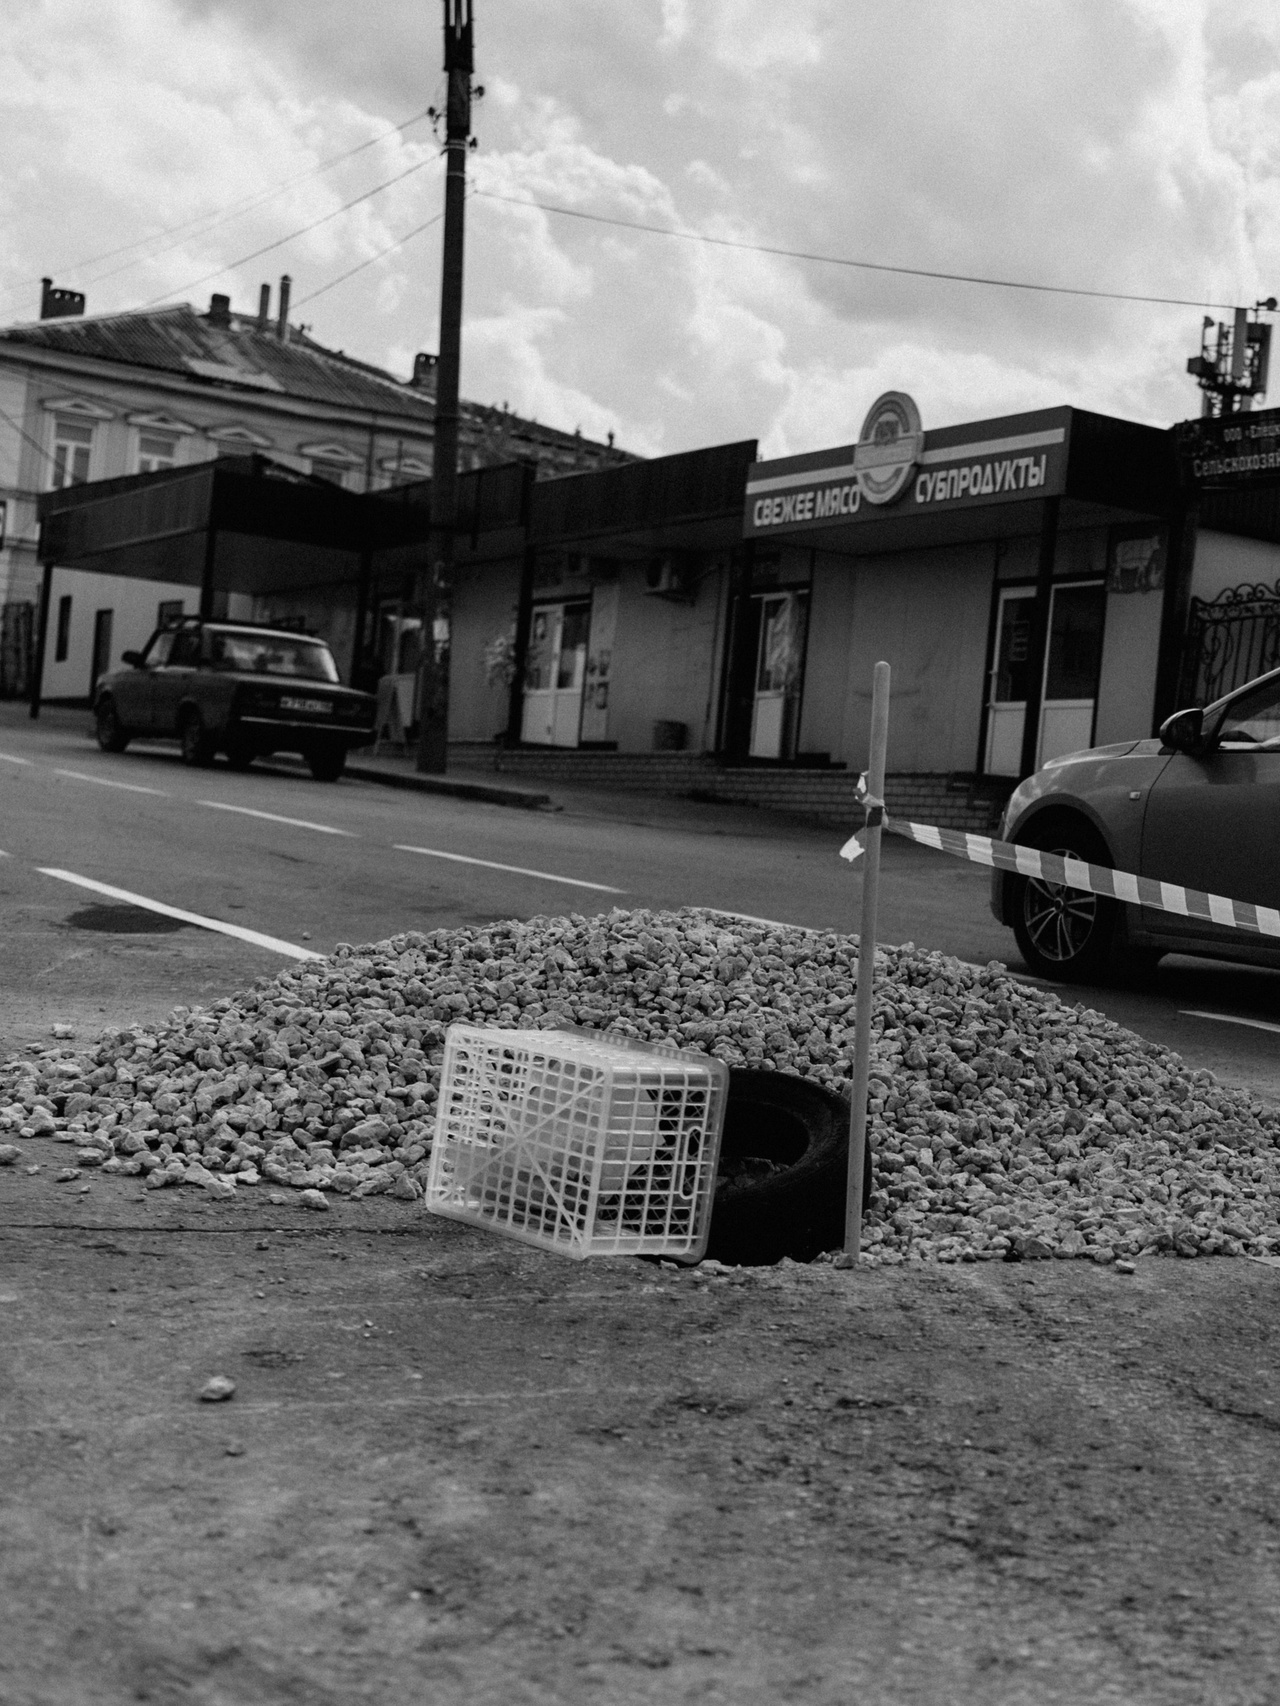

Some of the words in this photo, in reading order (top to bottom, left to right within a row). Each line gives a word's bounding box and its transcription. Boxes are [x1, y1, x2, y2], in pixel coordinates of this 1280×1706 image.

[915, 454, 1048, 504] СУБПРОДУКТЫ
[754, 492, 815, 527] СВЕЖЕЕ
[815, 485, 861, 519] МЯСО
